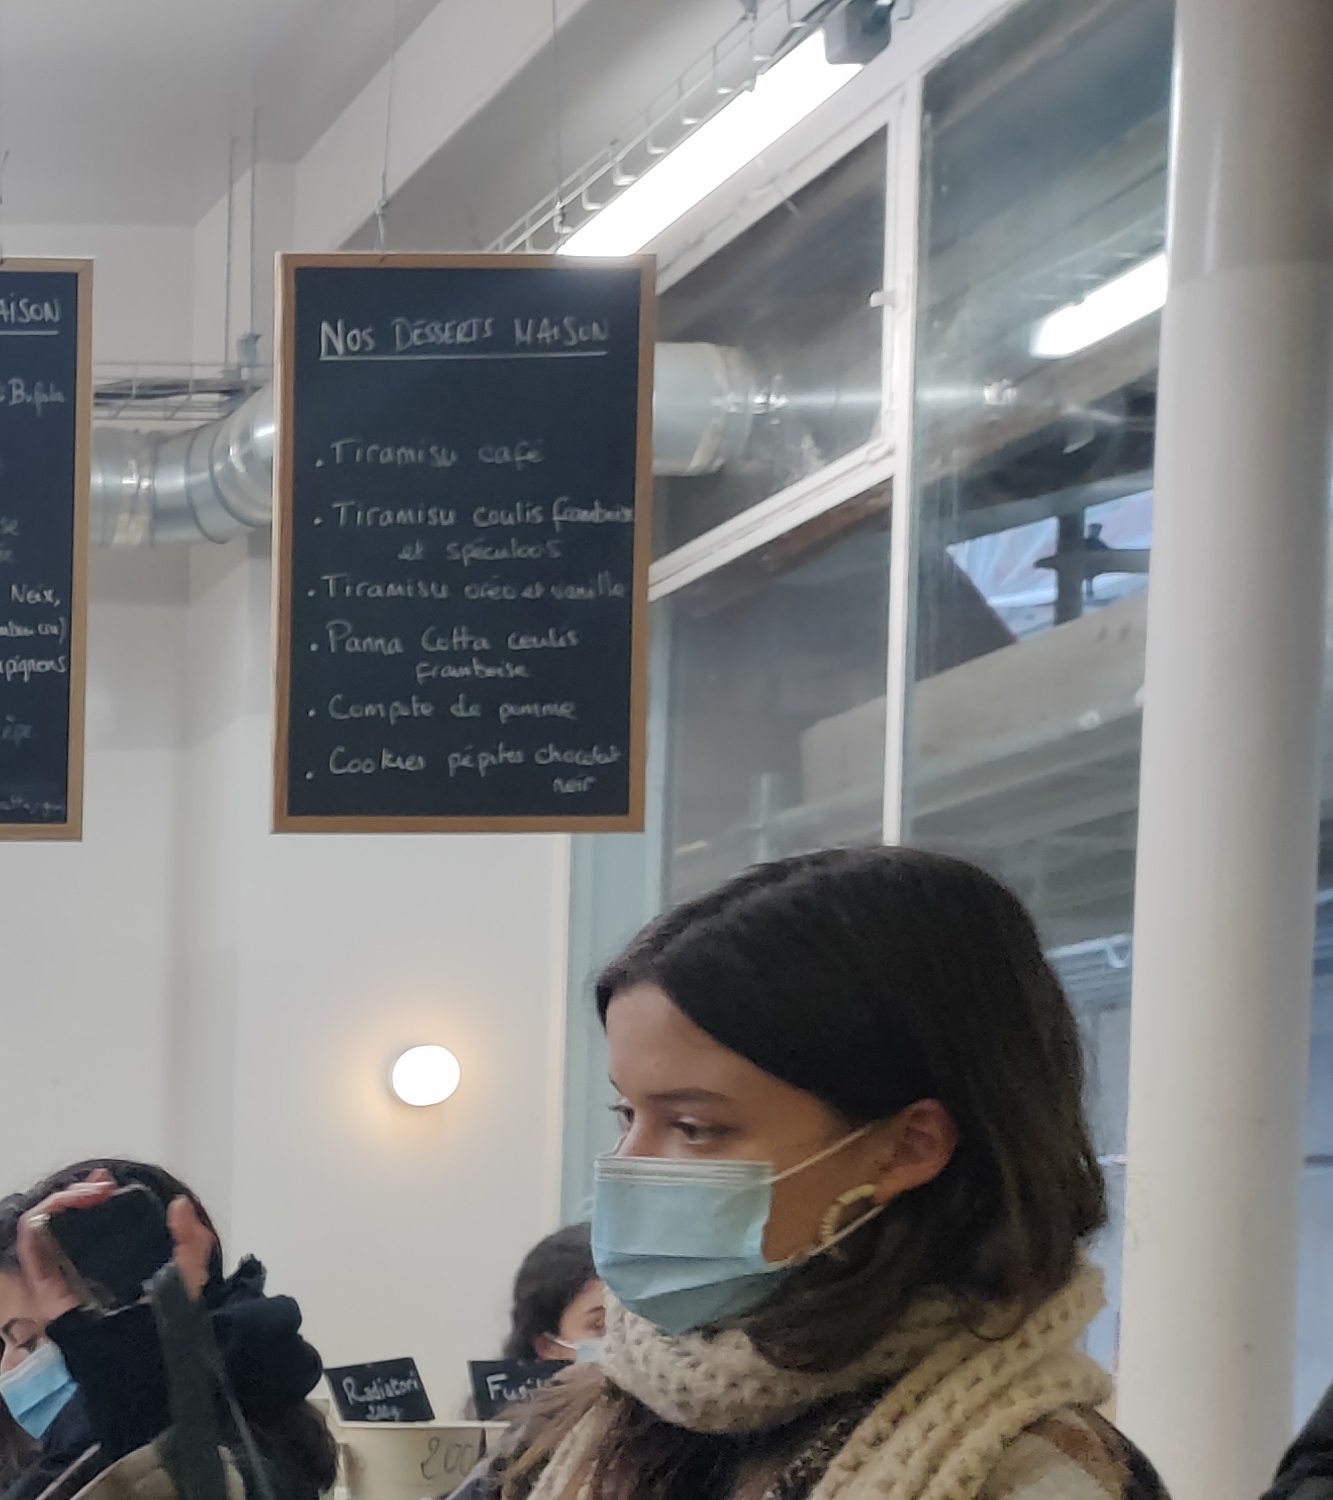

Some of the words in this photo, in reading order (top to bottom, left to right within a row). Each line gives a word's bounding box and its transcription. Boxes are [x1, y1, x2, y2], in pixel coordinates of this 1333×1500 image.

[514, 316, 609, 345] MAISON
[330, 438, 458, 468] Tiramisu
[478, 440, 544, 469] café
[333, 500, 457, 528] Tiramisu
[473, 500, 544, 527] coulis
[321, 573, 450, 599] Tiramisu
[551, 570, 626, 600] vanille
[326, 620, 404, 656] Panna
[421, 626, 492, 652] Cotta
[508, 627, 580, 650] coulis
[328, 694, 435, 726] Compote
[450, 694, 481, 718] de
[499, 699, 578, 724] pomme
[329, 746, 427, 775] Cookies
[448, 741, 525, 777] pépites
[534, 741, 622, 765] chocolat
[553, 774, 597, 793] noir
